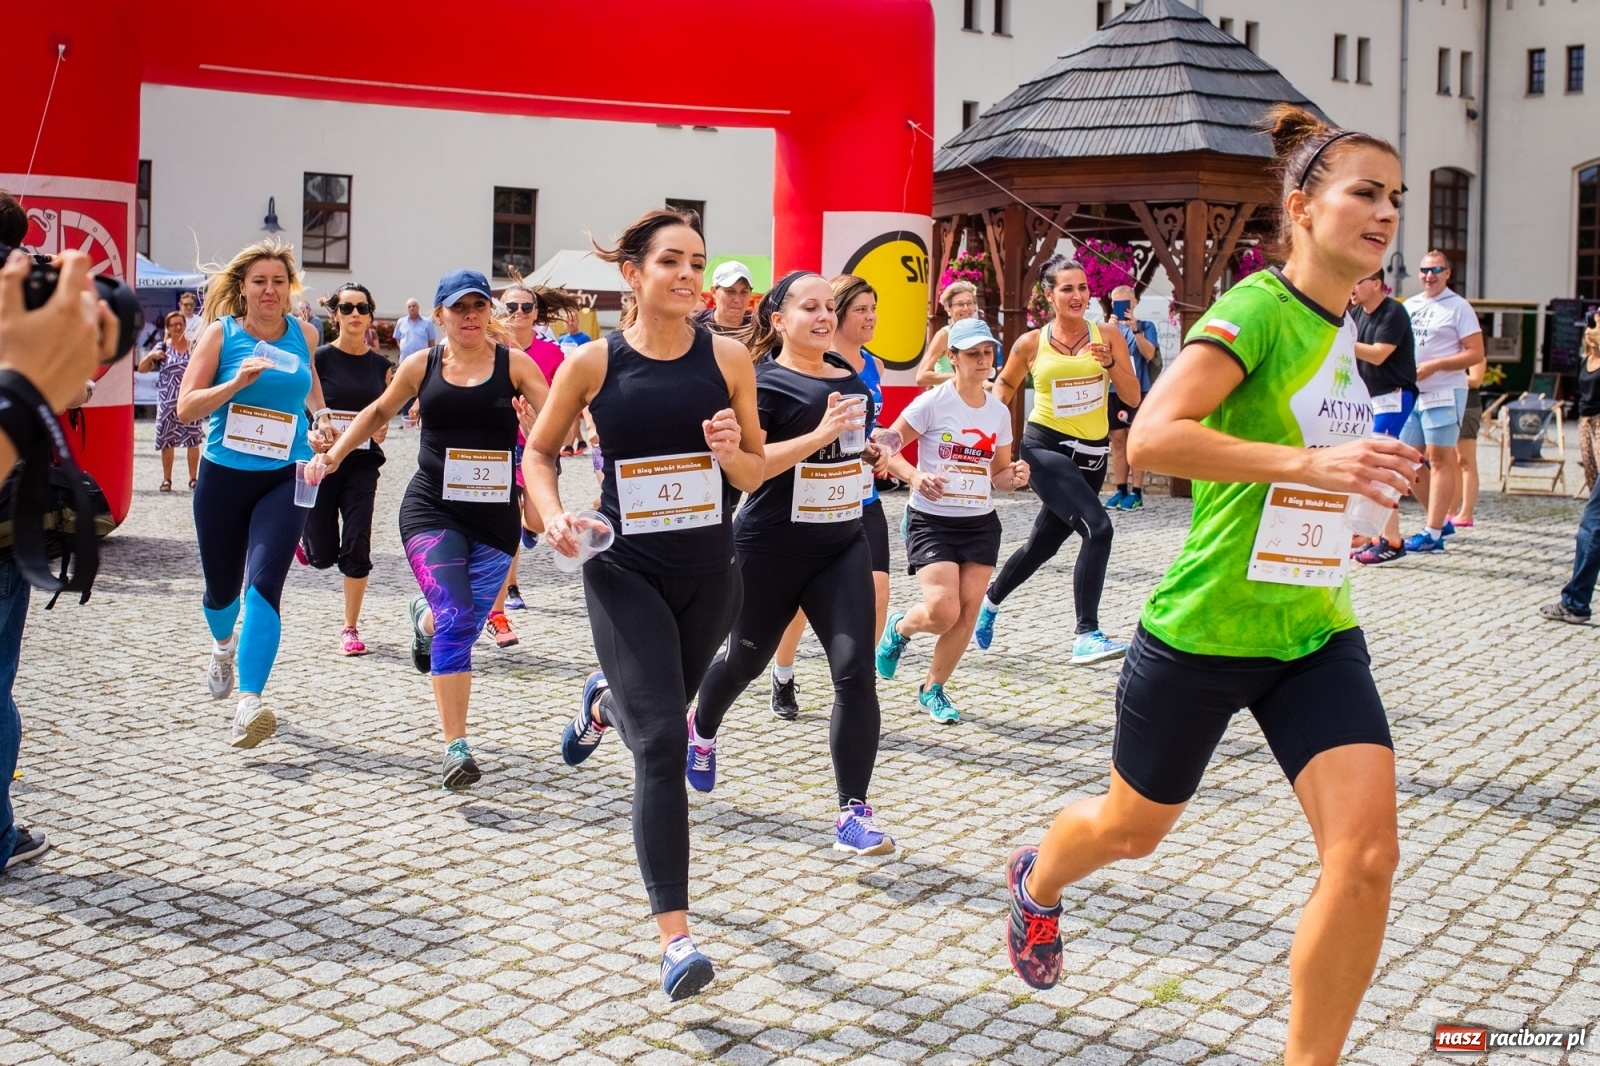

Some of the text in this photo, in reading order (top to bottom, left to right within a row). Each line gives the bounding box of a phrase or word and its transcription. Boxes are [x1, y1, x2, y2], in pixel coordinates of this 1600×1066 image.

[1076, 390, 1088, 400] 15
[256, 424, 264, 435] 4
[1330, 421, 1366, 435] LYSKI
[964, 448, 982, 456] BIEG
[952, 454, 980, 463] GRANIC
[473, 468, 490, 480] 32
[960, 480, 974, 490] 37
[658, 482, 684, 502] 42
[828, 485, 845, 501] 29
[1288, 497, 1303, 507] Bieg
[1305, 499, 1324, 507] Wokół
[1324, 501, 1344, 509] Komina
[1298, 523, 1323, 547] 30
